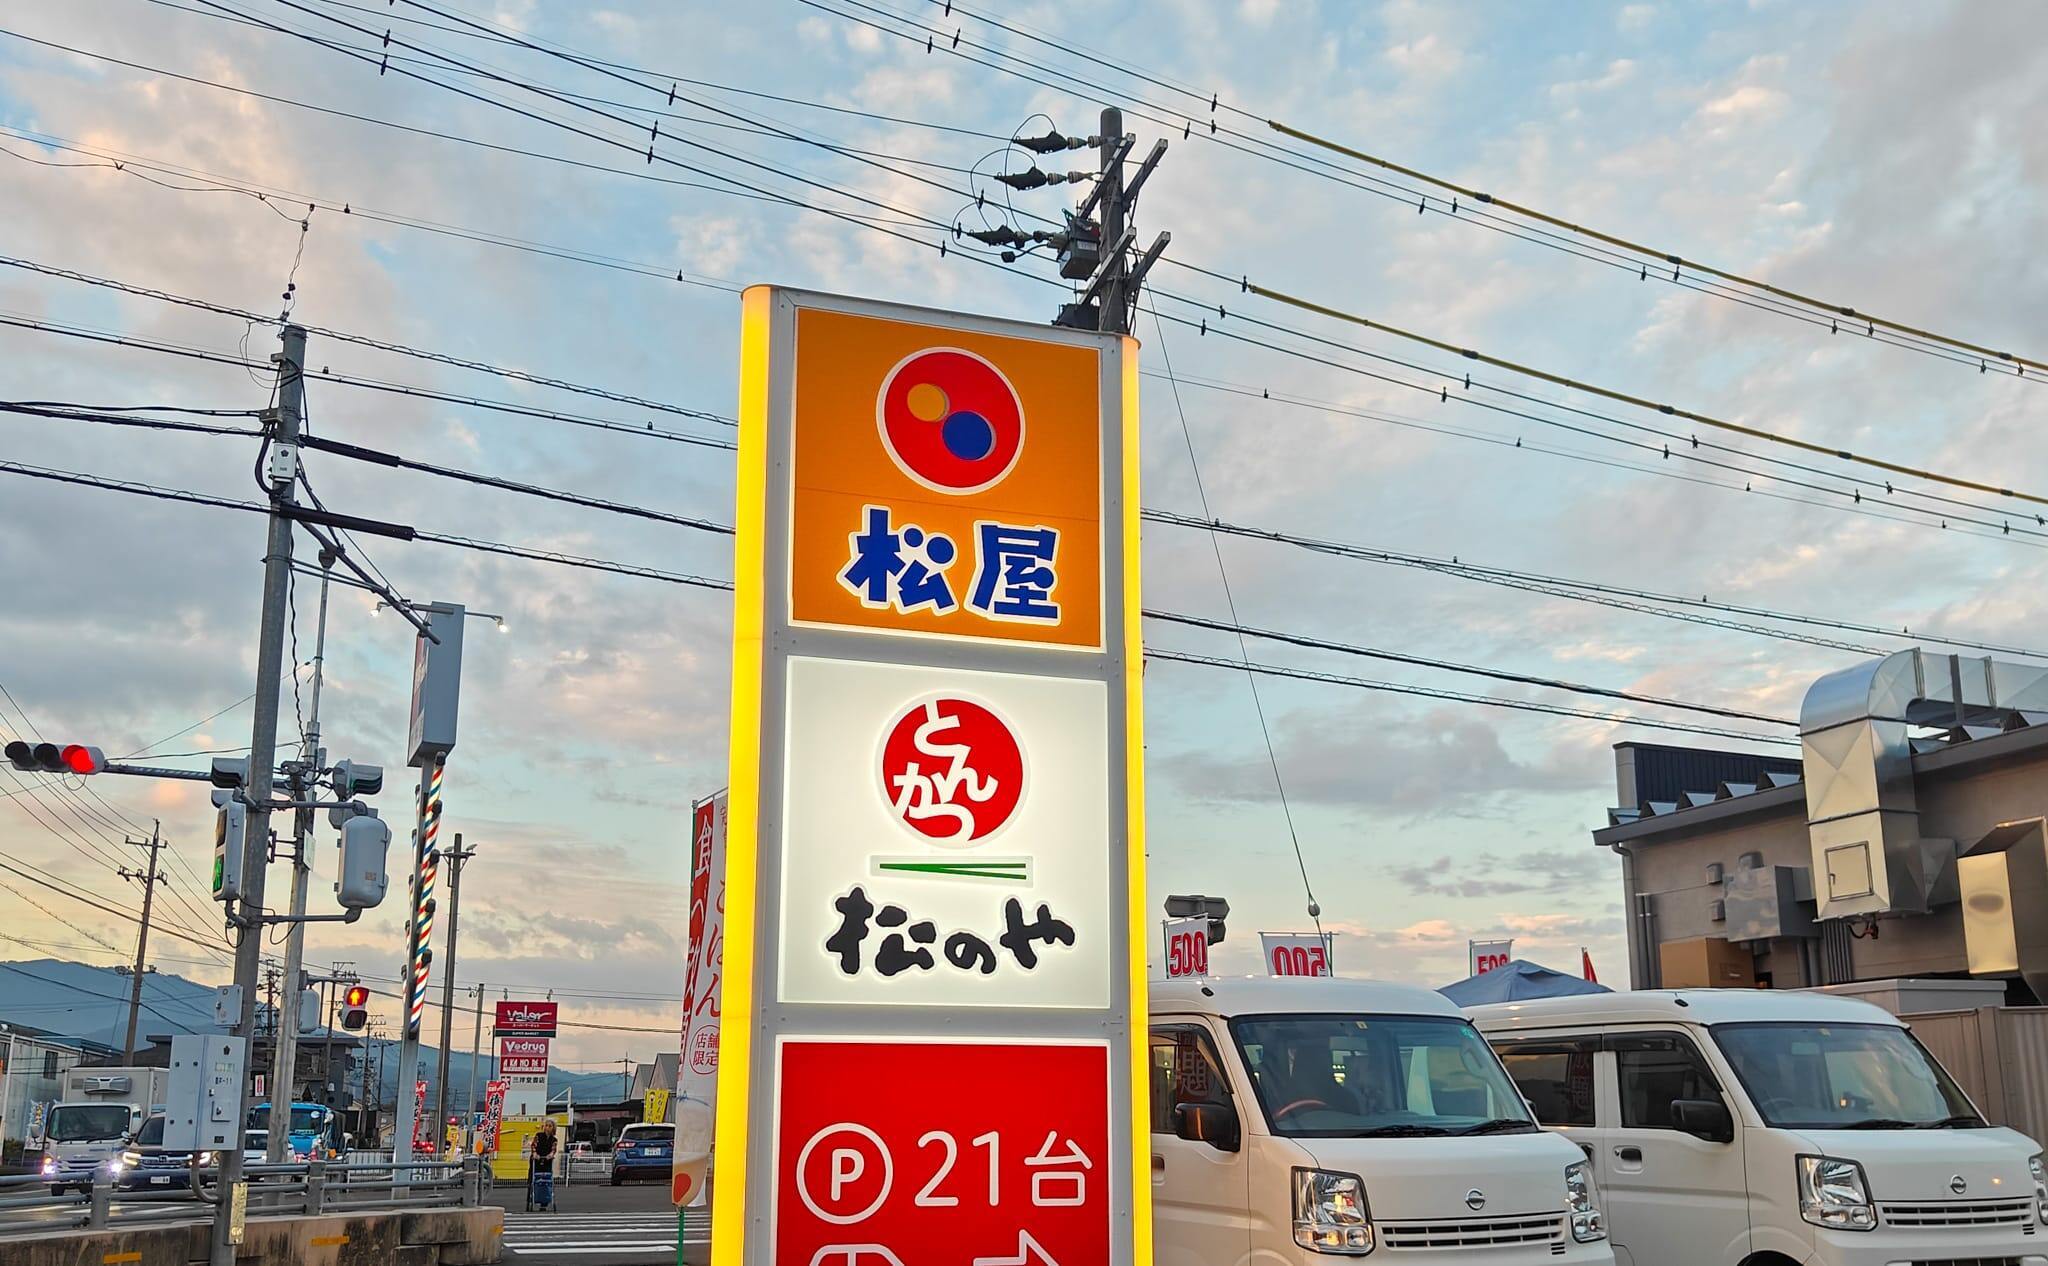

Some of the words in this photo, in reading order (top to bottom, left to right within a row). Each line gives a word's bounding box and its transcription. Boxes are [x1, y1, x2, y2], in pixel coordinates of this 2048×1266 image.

[844, 507, 1060, 620] 松屋
[893, 699, 999, 841] とんかつ
[826, 886, 1076, 977] 松のや
[1169, 930, 1207, 977] 500
[693, 1049, 719, 1067] 限定
[831, 1148, 865, 1202] P
[914, 1130, 1093, 1207] 21台
